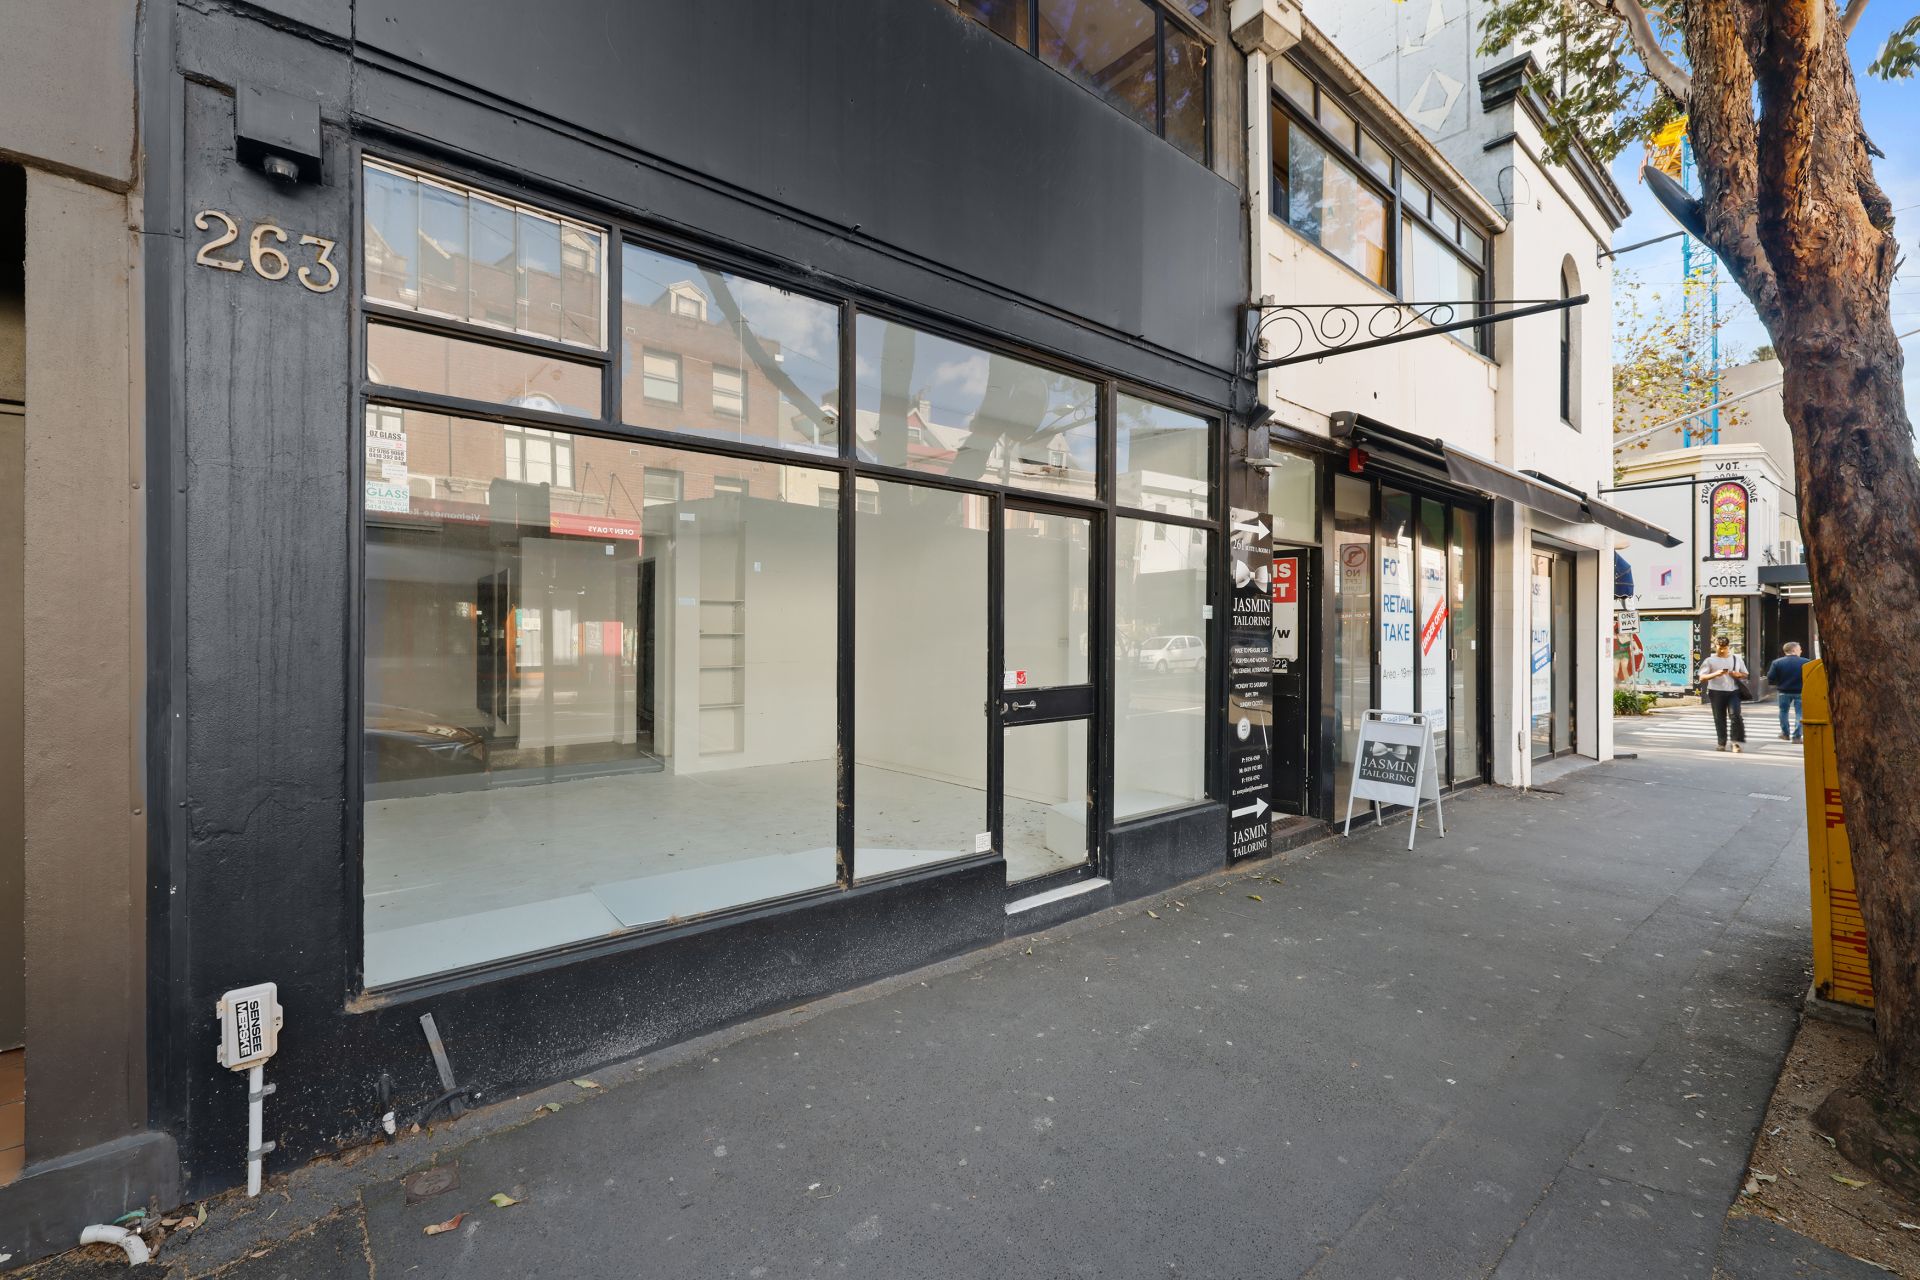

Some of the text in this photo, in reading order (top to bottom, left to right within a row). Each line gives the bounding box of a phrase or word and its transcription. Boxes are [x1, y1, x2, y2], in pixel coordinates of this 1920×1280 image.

[195, 210, 340, 293] 263
[380, 431, 402, 440] GLASS
[366, 487, 408, 500] GLASS
[1233, 538, 1245, 551] 261
[1383, 558, 1400, 577] FO
[1709, 576, 1747, 587] CORE
[1233, 598, 1270, 612] JASMIN
[1383, 594, 1414, 614] RETAIL
[1233, 615, 1270, 626] TAILORING
[1383, 623, 1411, 641] TAKE
[1362, 757, 1417, 774] JASMIN
[1362, 768, 1415, 784] TAILORING
[1233, 823, 1268, 845] JASMIN
[1233, 839, 1268, 858] TAILORING
[237, 1003, 250, 1056] MERSKE
[250, 1001, 262, 1052] SENSEE
